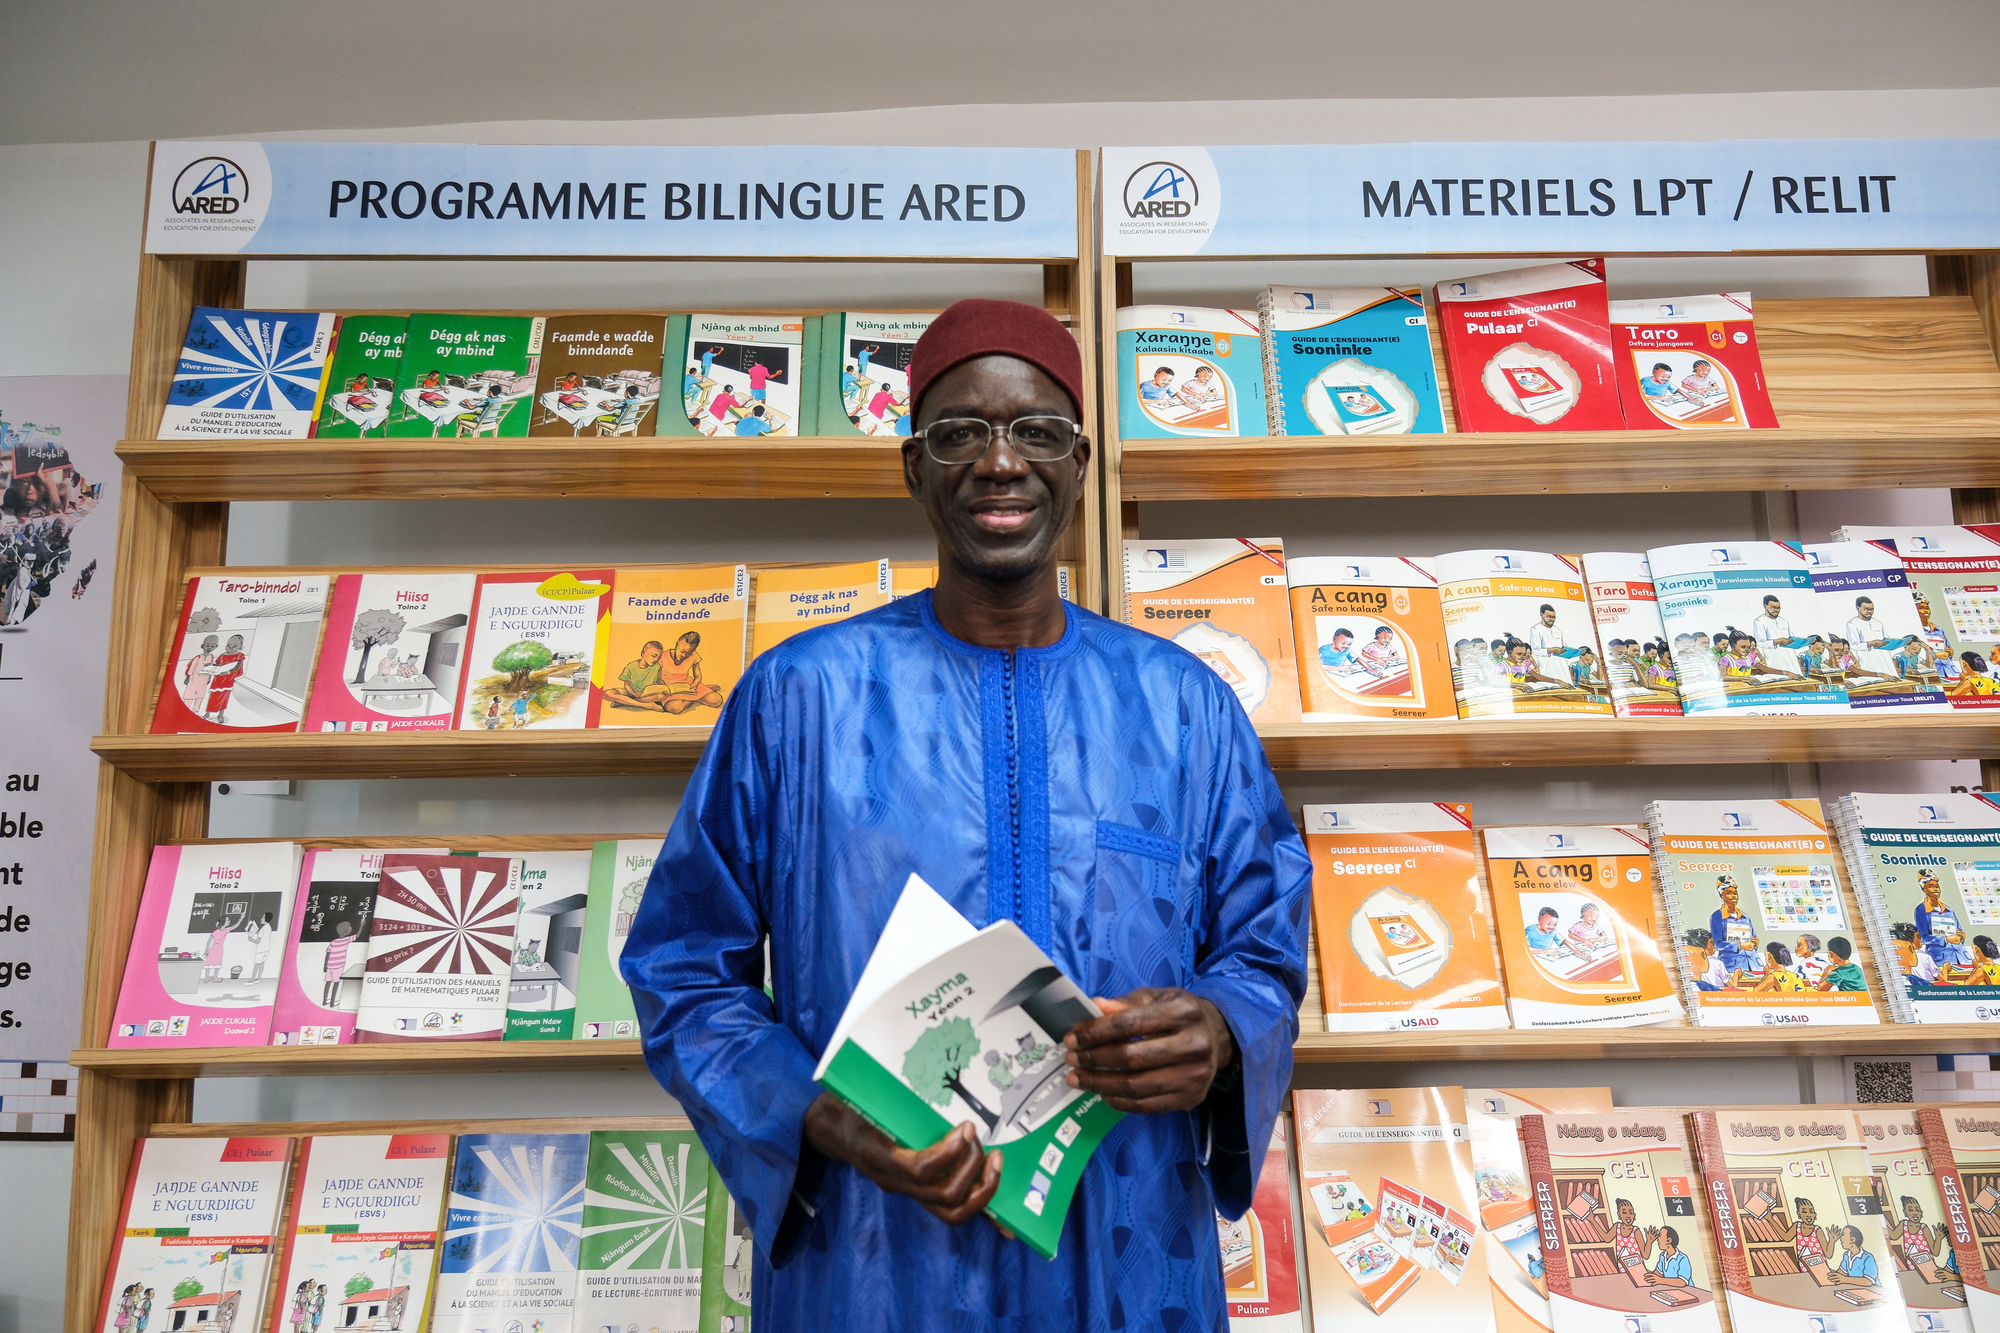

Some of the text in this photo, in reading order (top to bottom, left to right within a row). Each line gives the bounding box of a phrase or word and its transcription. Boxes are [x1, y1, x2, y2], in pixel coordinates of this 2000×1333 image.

[329, 180, 1026, 223] PROGRAMME BILINGUE ARED
[1362, 170, 1897, 222] MATERIELS LPT / RELIT
[180, 197, 239, 214] ARED
[1132, 201, 1191, 218] ARED
[701, 322, 780, 333] Njàng ak mbind
[1625, 326, 1679, 340] Taro
[430, 329, 506, 343] Dégg ak nas
[552, 330, 600, 343] Faamde
[603, 333, 610, 341] e
[436, 345, 495, 357] ay mbind
[1135, 345, 1214, 355] Kalaasin kitaabe
[1293, 344, 1372, 355] Sooninke
[181, 362, 239, 374] Vivre ensemble
[225, 412, 276, 420] D'UTILISATION
[1857, 576, 1882, 584] safoo
[219, 580, 301, 594] Taro-binndol
[1443, 584, 1490, 598] A cang
[1498, 584, 1519, 592] Safe
[1535, 585, 1555, 593] elew
[1593, 586, 1626, 596] Taro
[396, 590, 429, 602] Hiisa
[628, 596, 676, 606] Faamde
[790, 590, 858, 604] Dégg ak nas
[1311, 587, 1387, 609] A cang
[1312, 605, 1333, 613] Safe
[1351, 605, 1383, 613] kalaas
[1665, 598, 1708, 609] Sooninke
[532, 605, 585, 616] GANNDE
[797, 603, 850, 617] ay mbind
[1144, 607, 1211, 619] Seereer
[1445, 604, 1481, 616] Seereer
[1597, 606, 1627, 614] Pulaar
[490, 619, 583, 630] E NGUURDIIGU
[1392, 709, 1427, 717] Seereer
[5, 773, 39, 792] au
[1869, 833, 1919, 843] GUIDE DE
[1330, 846, 1357, 854] GUIDE
[1359, 846, 1371, 854] DE
[1670, 840, 1704, 849] GUIDE
[1705, 840, 1720, 849] DE
[1678, 860, 1734, 872] Seereer
[1880, 854, 1947, 866] Sooninke
[209, 866, 242, 880] Hiisa
[1513, 861, 1593, 882] A cang
[1514, 880, 1576, 889] Safe no elew
[391, 977, 447, 985] D'UTILISATION
[403, 986, 470, 995] MATHEMATIQUES
[905, 972, 969, 1019] Xayma
[1604, 994, 1643, 1004] Seereer
[1401, 1017, 1439, 1028] USAID
[1776, 1015, 1809, 1023] USAID
[1303, 1097, 1335, 1130] Seereer
[1453, 1128, 1461, 1137] CI
[1556, 1123, 1667, 1142] Ndang o ndang
[1730, 1121, 1847, 1141] Ndang o ndang
[1608, 1160, 1650, 1179] CE1
[1786, 1159, 1830, 1178] CE1
[201, 1180, 259, 1193] GANNDE
[368, 1177, 424, 1190] GANNDE
[1853, 1184, 1861, 1194] 7
[1671, 1185, 1680, 1195] 6
[152, 1199, 256, 1211] E NGUURDIIGU
[322, 1195, 422, 1209] E NGUURDIIGU
[1675, 1204, 1684, 1214] 4
[1712, 1180, 1738, 1249] SEEREER
[1859, 1204, 1867, 1214] 3
[1941, 1175, 1971, 1244] SEEREER
[452, 1213, 472, 1222] Vivre
[1536, 1181, 1560, 1251] SEEREER
[587, 1276, 685, 1285] GUIDE D'UTILISATION DU
[592, 1287, 683, 1298] DE LECTURE-ÉCRITURE
[1237, 1305, 1270, 1314] Pulaar
